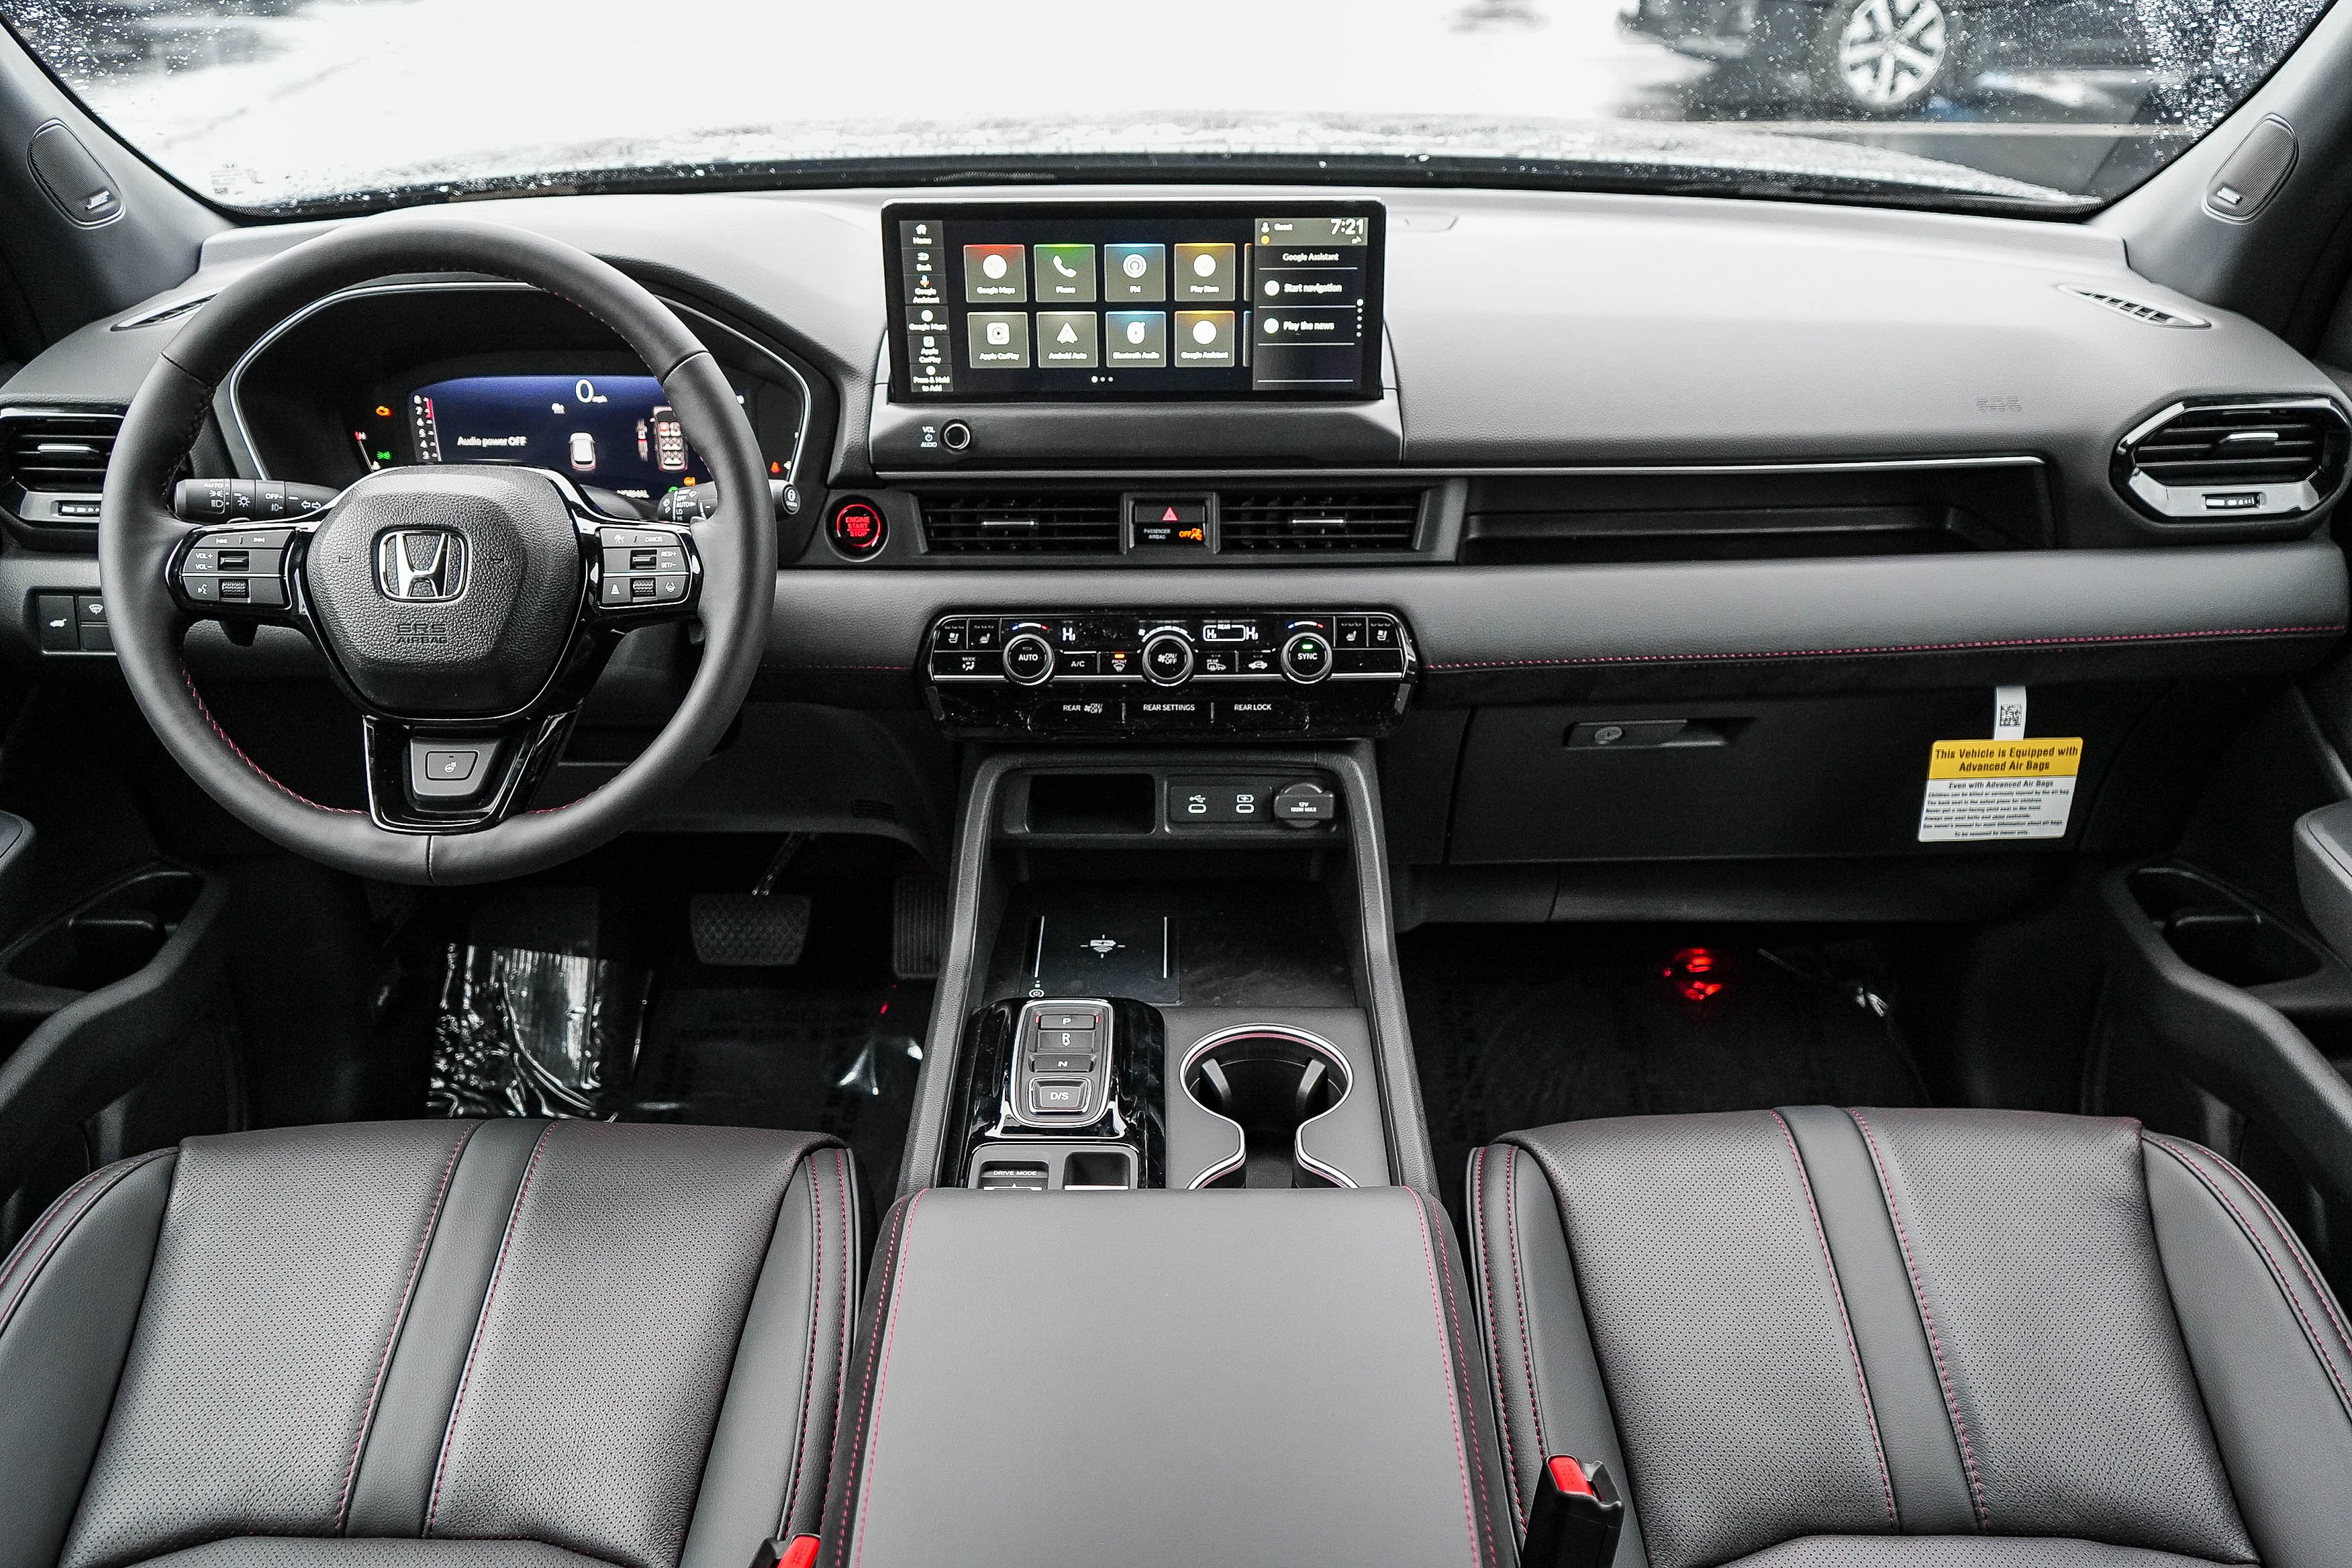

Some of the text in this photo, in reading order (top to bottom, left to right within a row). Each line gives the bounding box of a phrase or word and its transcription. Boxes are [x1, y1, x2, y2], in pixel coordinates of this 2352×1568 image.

[1330, 218, 1364, 235] 7:21
[1283, 253, 1339, 262] Google Assistant
[1284, 283, 1342, 293] Start navigation
[1283, 321, 1334, 332] Play the news
[575, 379, 594, 403] 0
[457, 436, 528, 448] Audio power OFF
[1297, 652, 1318, 660] SYNC
[1935, 745, 2078, 759] This Vehicle is Equipped with
[1959, 760, 2050, 773] Advanced Air Bags
[1949, 781, 1967, 789] Even
[1969, 781, 1984, 789] with
[1986, 780, 2022, 789] Advanced
[2036, 780, 2055, 788] Bags
[1062, 1017, 1072, 1026] P
[1061, 1032, 1071, 1042] R
[1049, 1091, 1069, 1101] D/S
